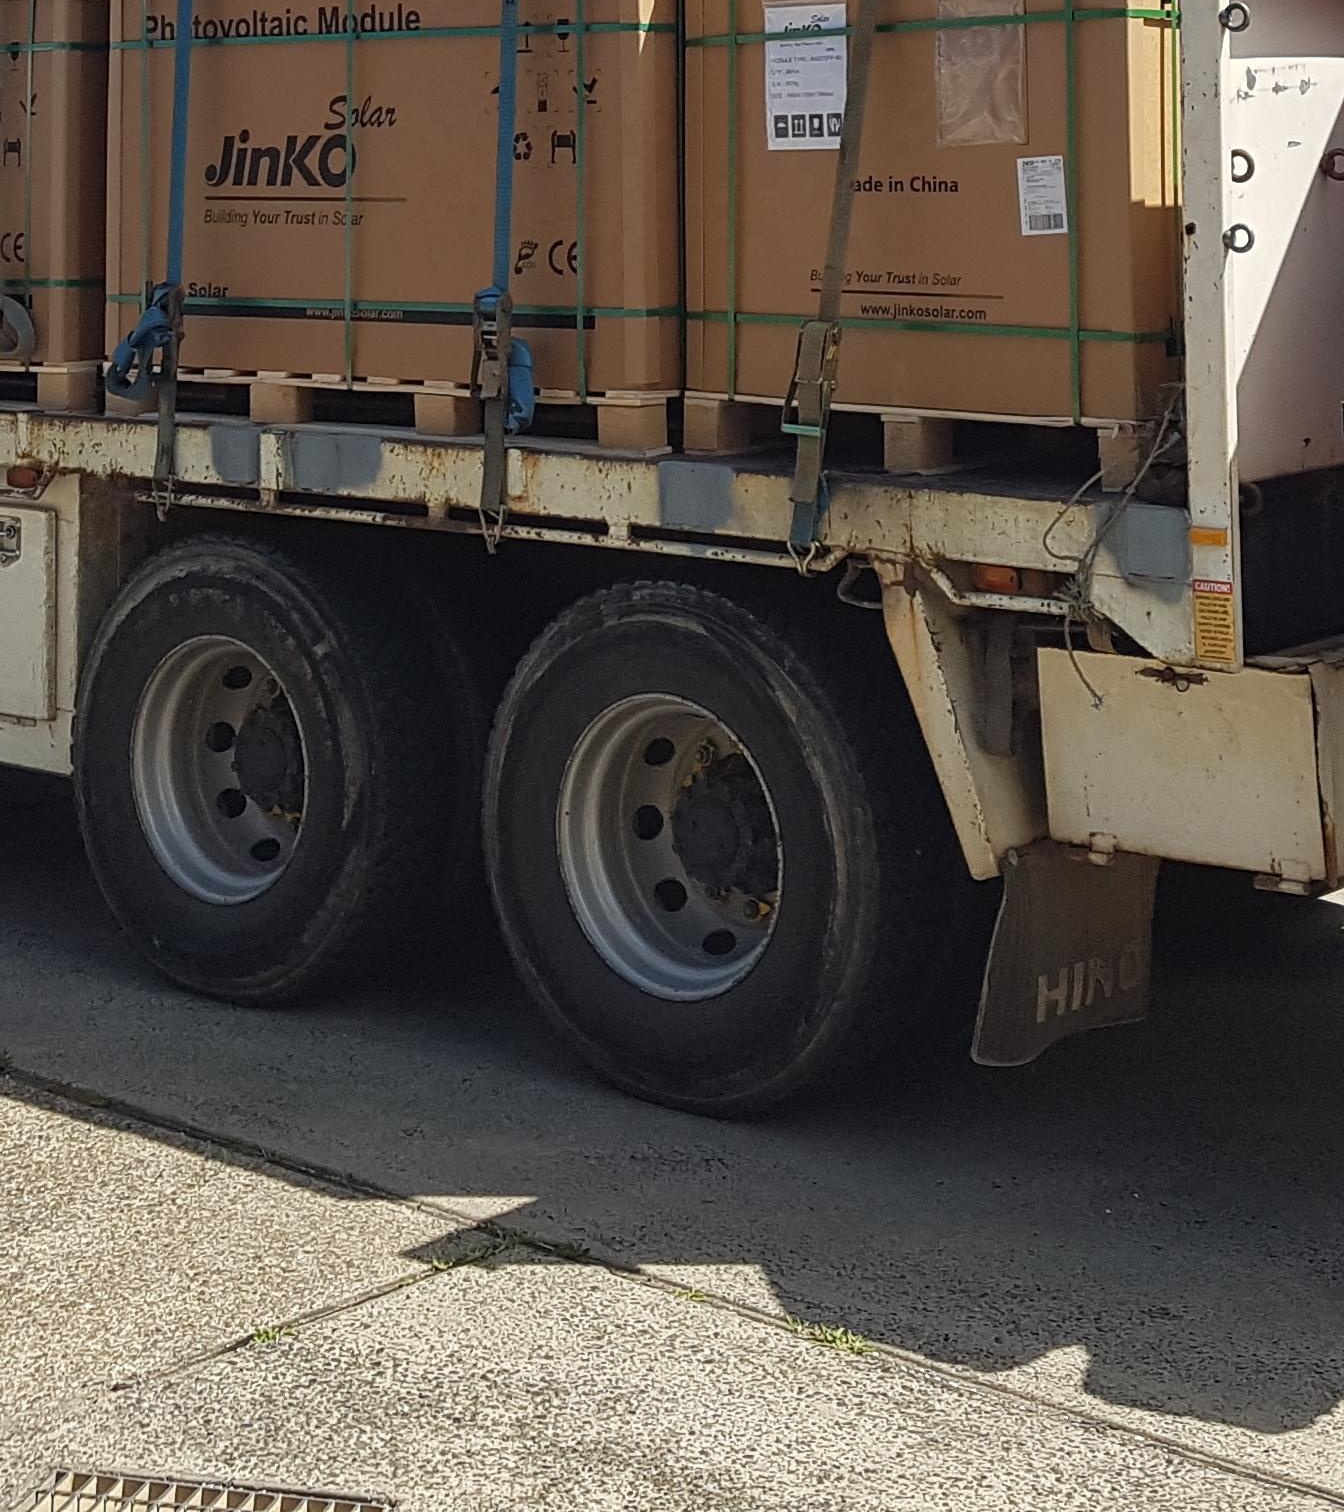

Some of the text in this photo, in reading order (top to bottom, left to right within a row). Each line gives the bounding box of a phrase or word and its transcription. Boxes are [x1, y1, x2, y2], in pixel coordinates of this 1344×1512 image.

[205, 129, 357, 187] JinKO
[853, 176, 959, 193] ade in China
[204, 209, 364, 228] Building Your Trust in Soar
[856, 270, 882, 284] Your
[886, 271, 916, 285] Trust
[918, 272, 929, 285] in
[932, 272, 962, 287] Solar
[187, 281, 229, 298] Solar
[860, 303, 987, 321] www.jinkosolar.com
